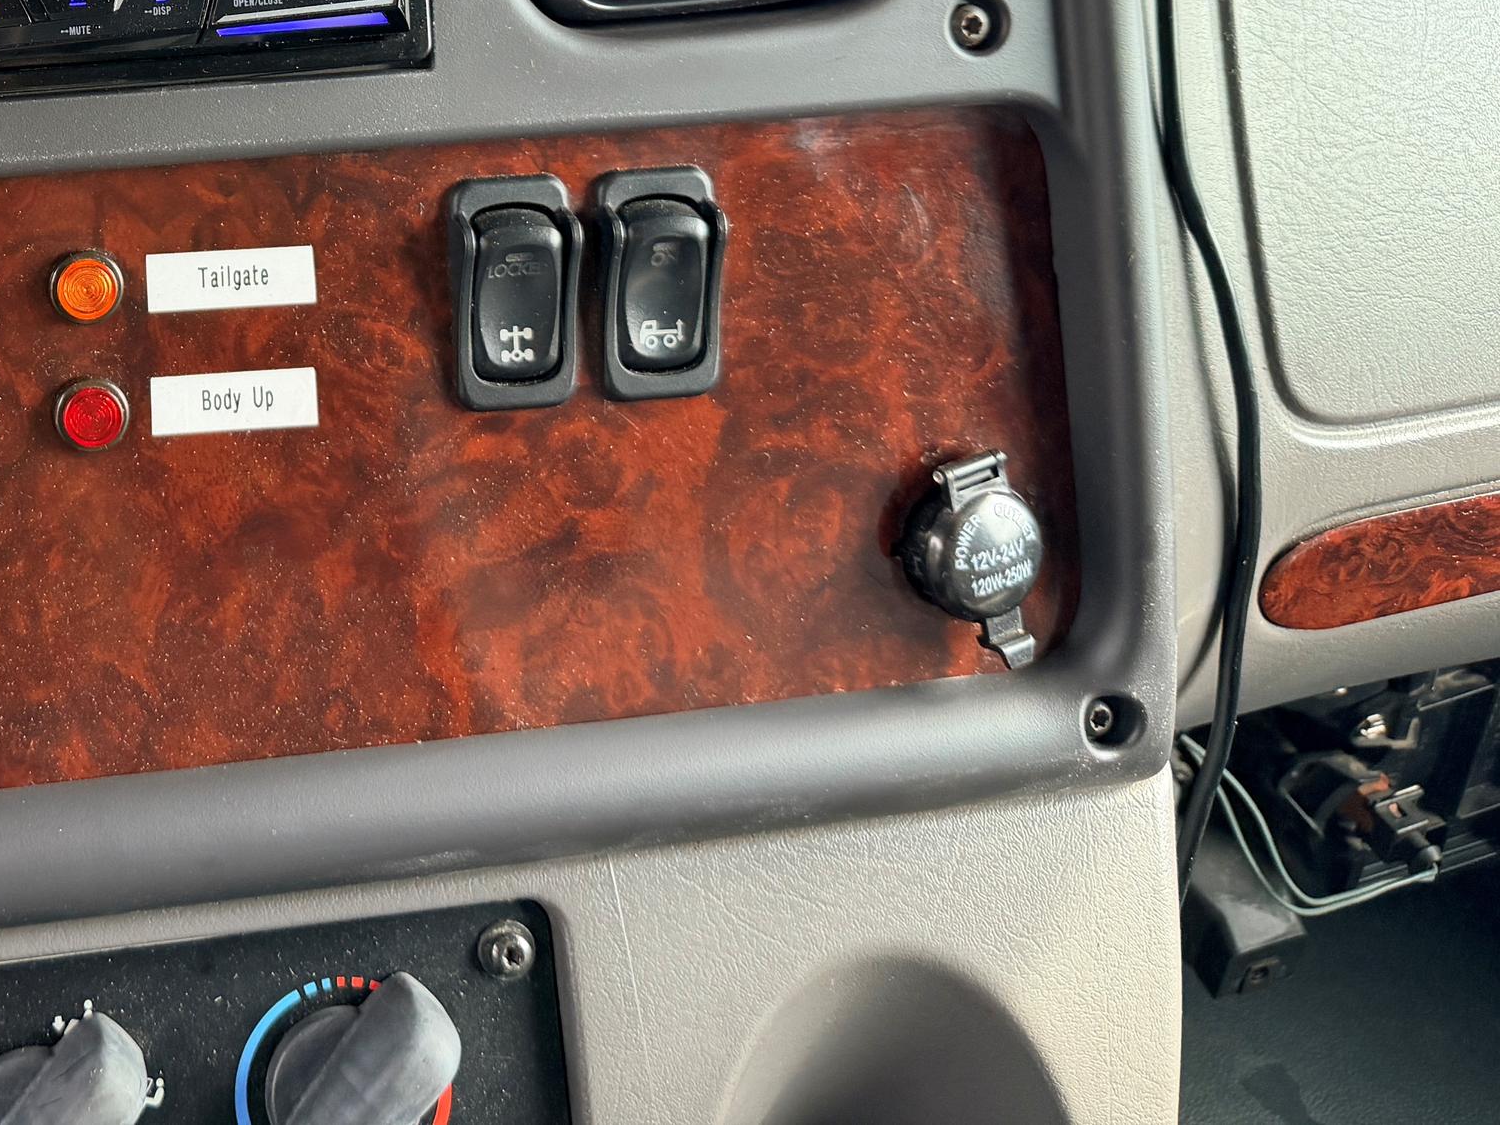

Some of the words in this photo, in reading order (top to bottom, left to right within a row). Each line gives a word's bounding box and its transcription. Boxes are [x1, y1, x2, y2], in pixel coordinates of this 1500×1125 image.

[153, 5, 172, 16] DISP
[69, 25, 91, 36] MUTE
[198, 264, 270, 290] Tailgate
[201, 389, 241, 414] Body
[252, 385, 275, 412] Up
[954, 513, 982, 571] POWER
